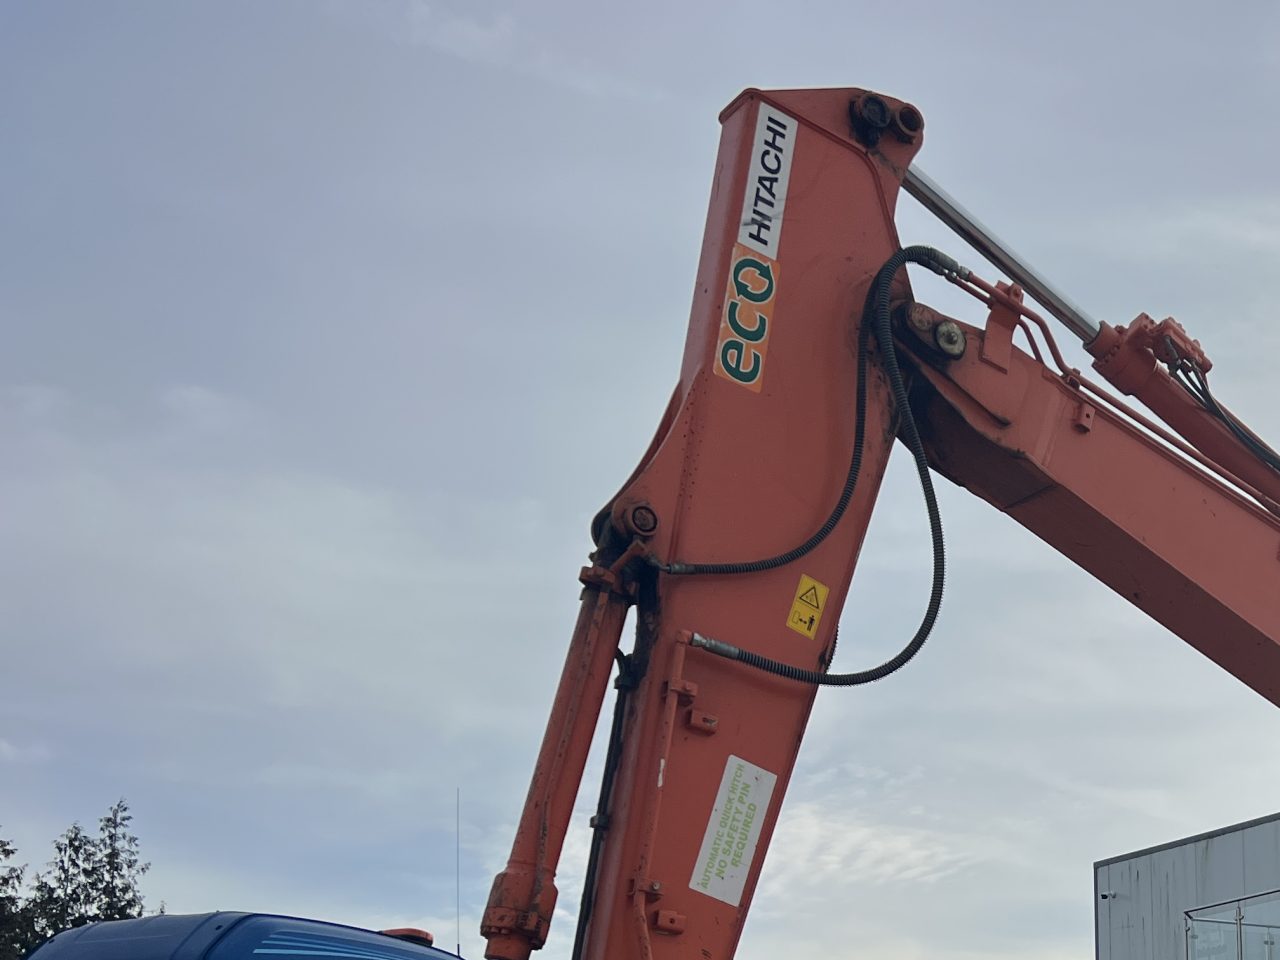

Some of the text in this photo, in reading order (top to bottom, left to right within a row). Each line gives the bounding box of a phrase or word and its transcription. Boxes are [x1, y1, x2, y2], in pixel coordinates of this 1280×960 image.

[748, 115, 787, 246] HITACHI
[700, 763, 745, 889] AUTOMATIC QUICK HITCH
[715, 782, 751, 879] NO SAFETY PIN
[730, 802, 757, 868] REQUIRED
